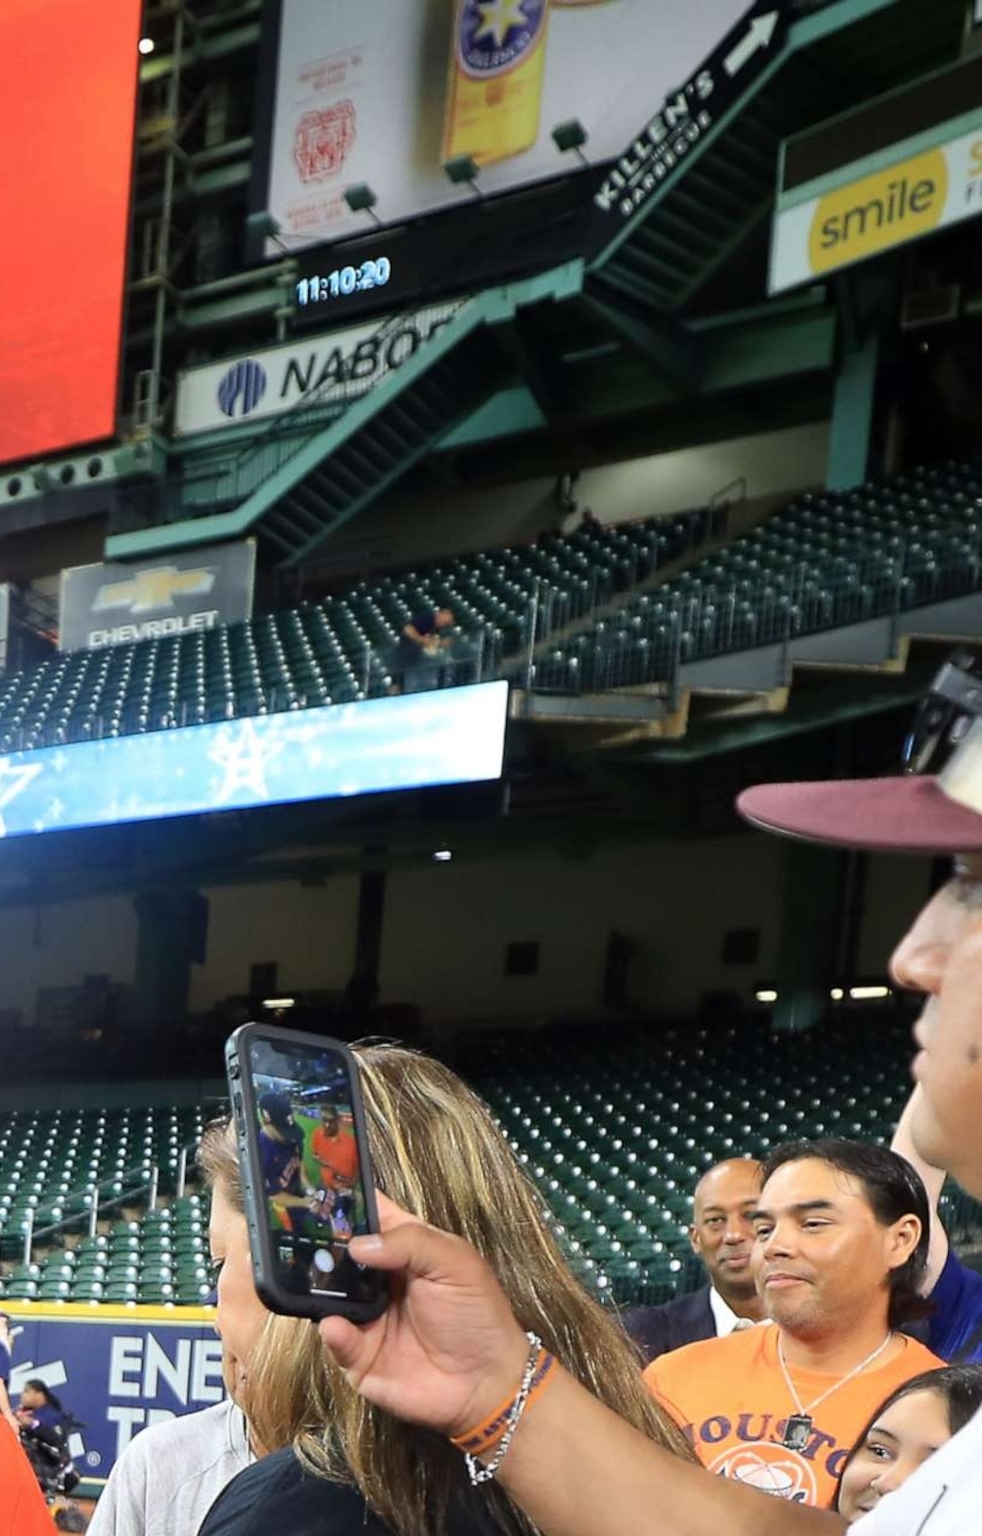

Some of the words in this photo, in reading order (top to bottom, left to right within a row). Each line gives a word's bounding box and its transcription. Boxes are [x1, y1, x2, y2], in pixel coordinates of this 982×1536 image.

[593, 69, 714, 212] KILLEN'S
[820, 177, 936, 249] smile
[296, 256, 392, 306] 11:10:20
[87, 609, 220, 649] CHEVROLET
